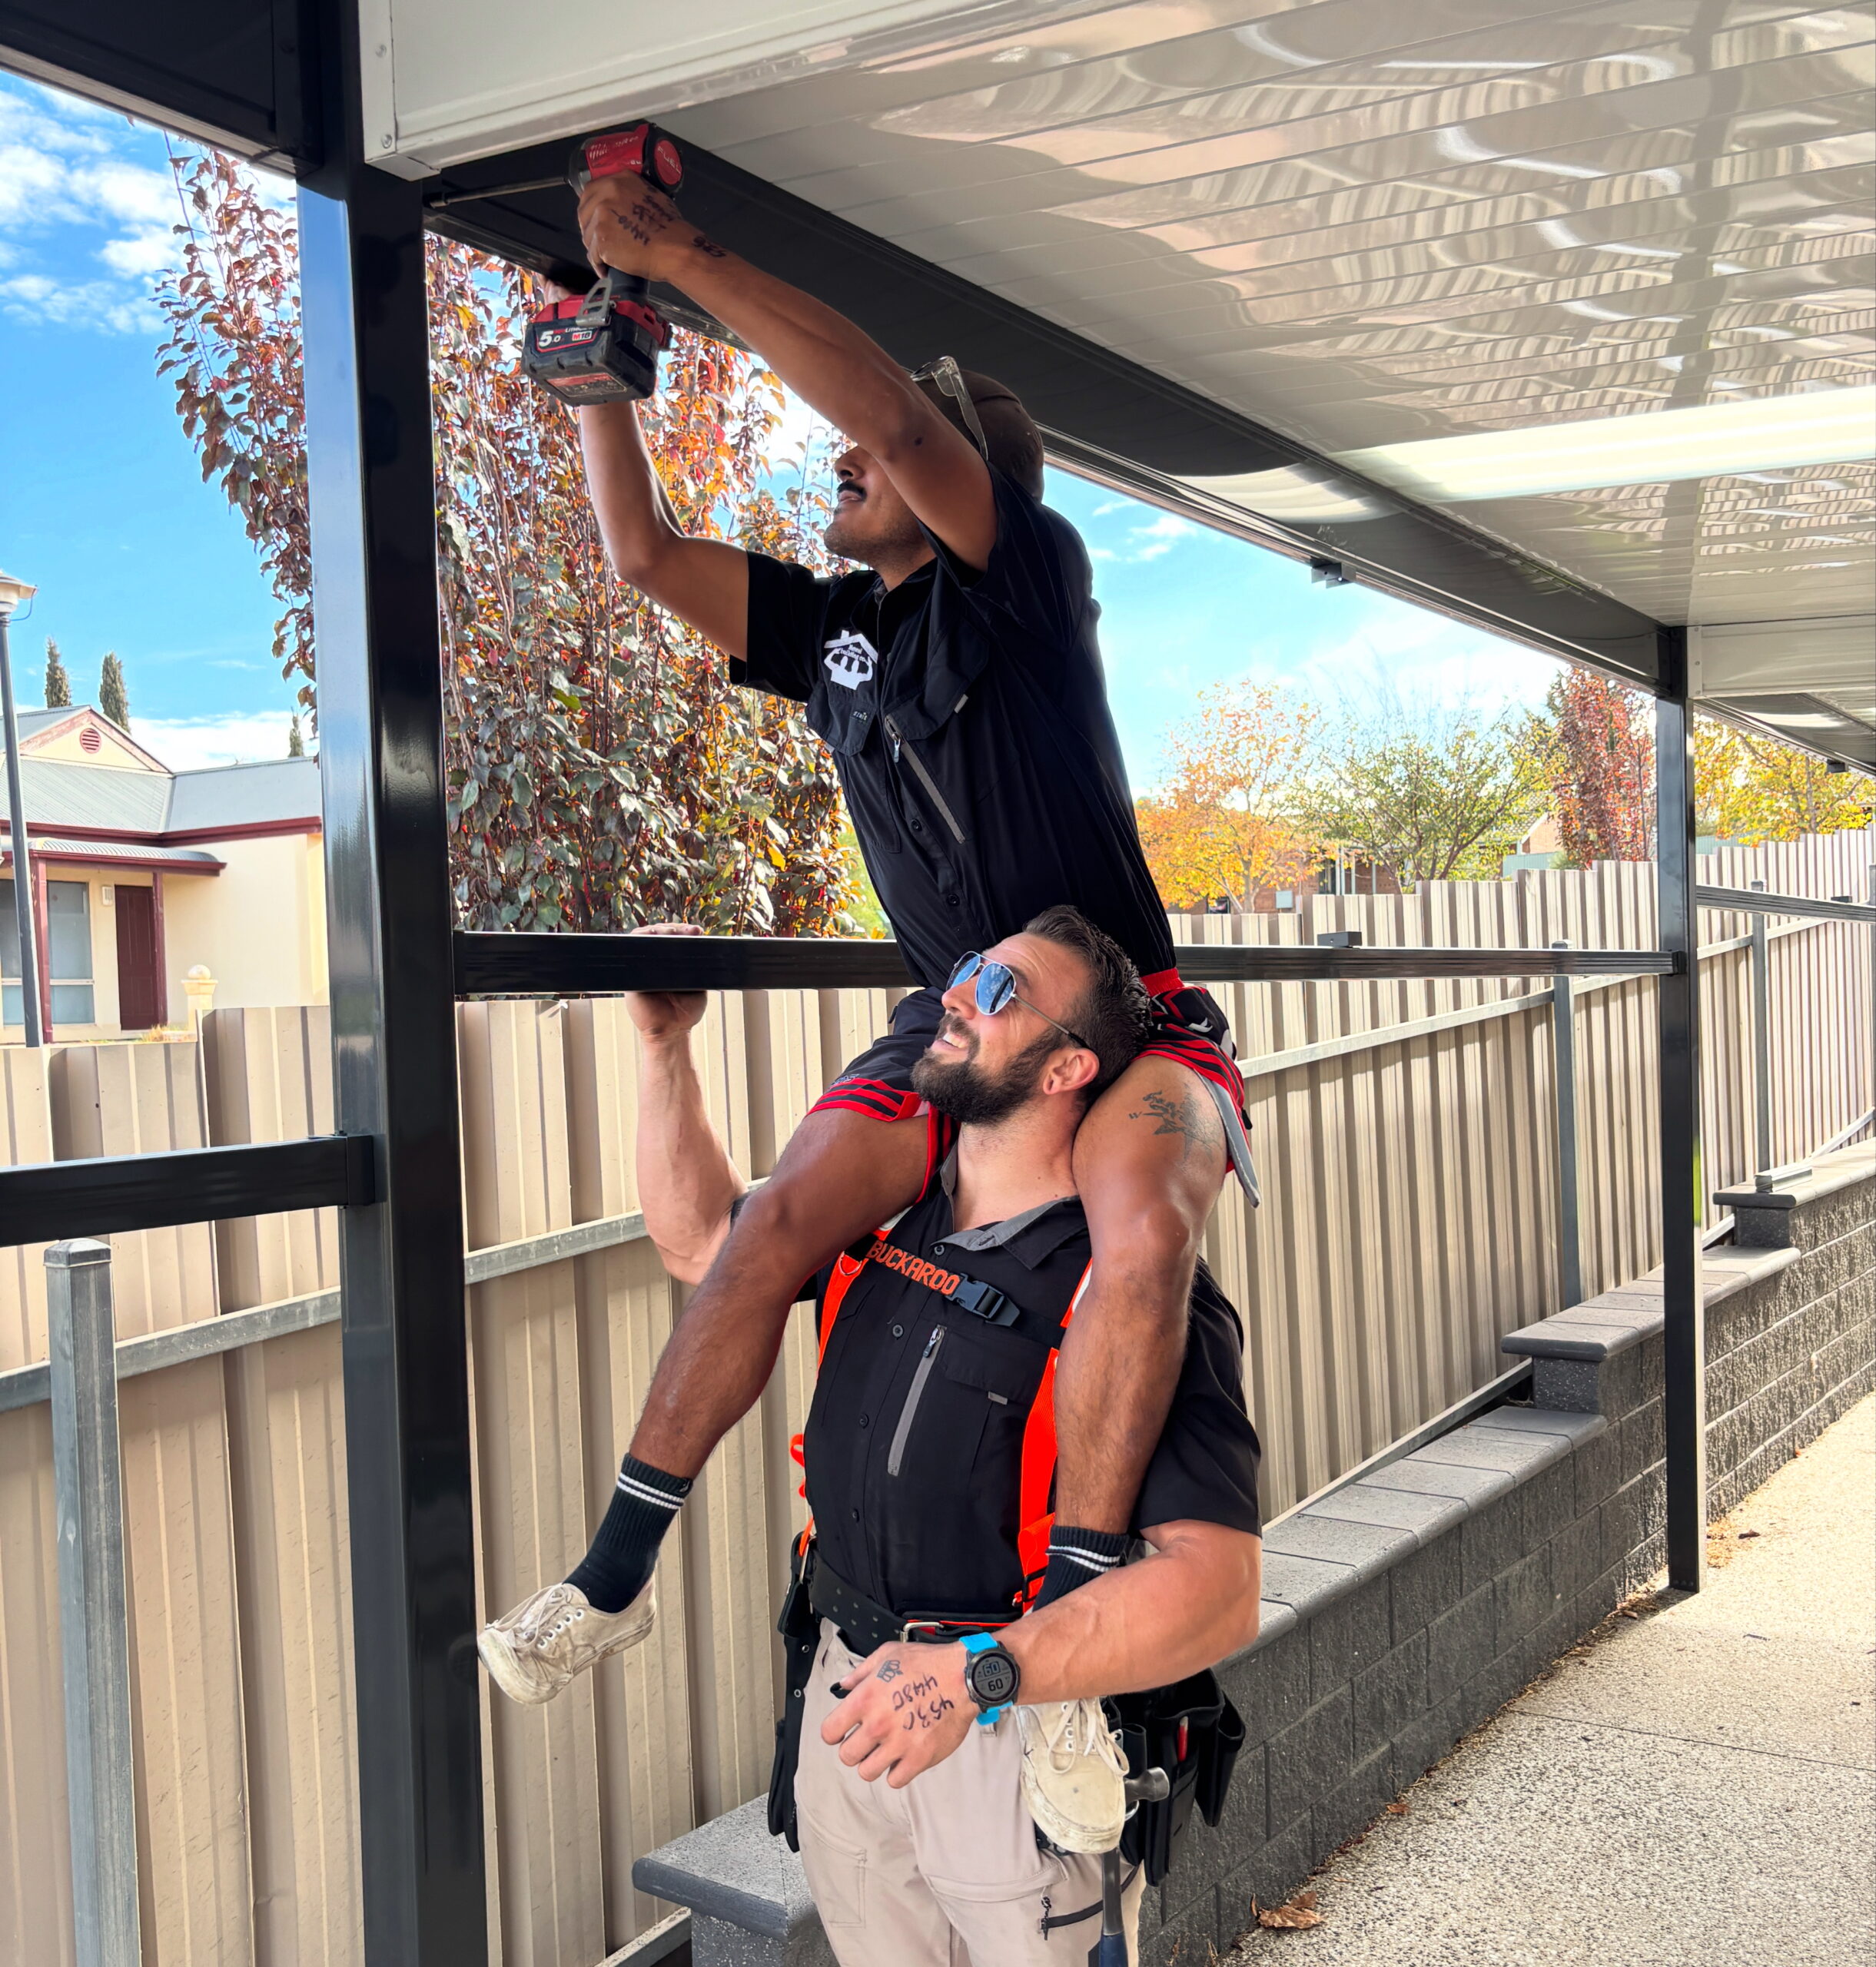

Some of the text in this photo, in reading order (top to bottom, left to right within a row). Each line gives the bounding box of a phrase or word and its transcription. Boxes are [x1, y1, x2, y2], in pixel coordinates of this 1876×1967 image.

[658, 146, 682, 174] FUEL
[539, 330, 561, 347] 5.0
[866, 1239, 960, 1295] BUCKAROO
[984, 1662, 1000, 1676] 60
[988, 1678, 1004, 1691] 60
